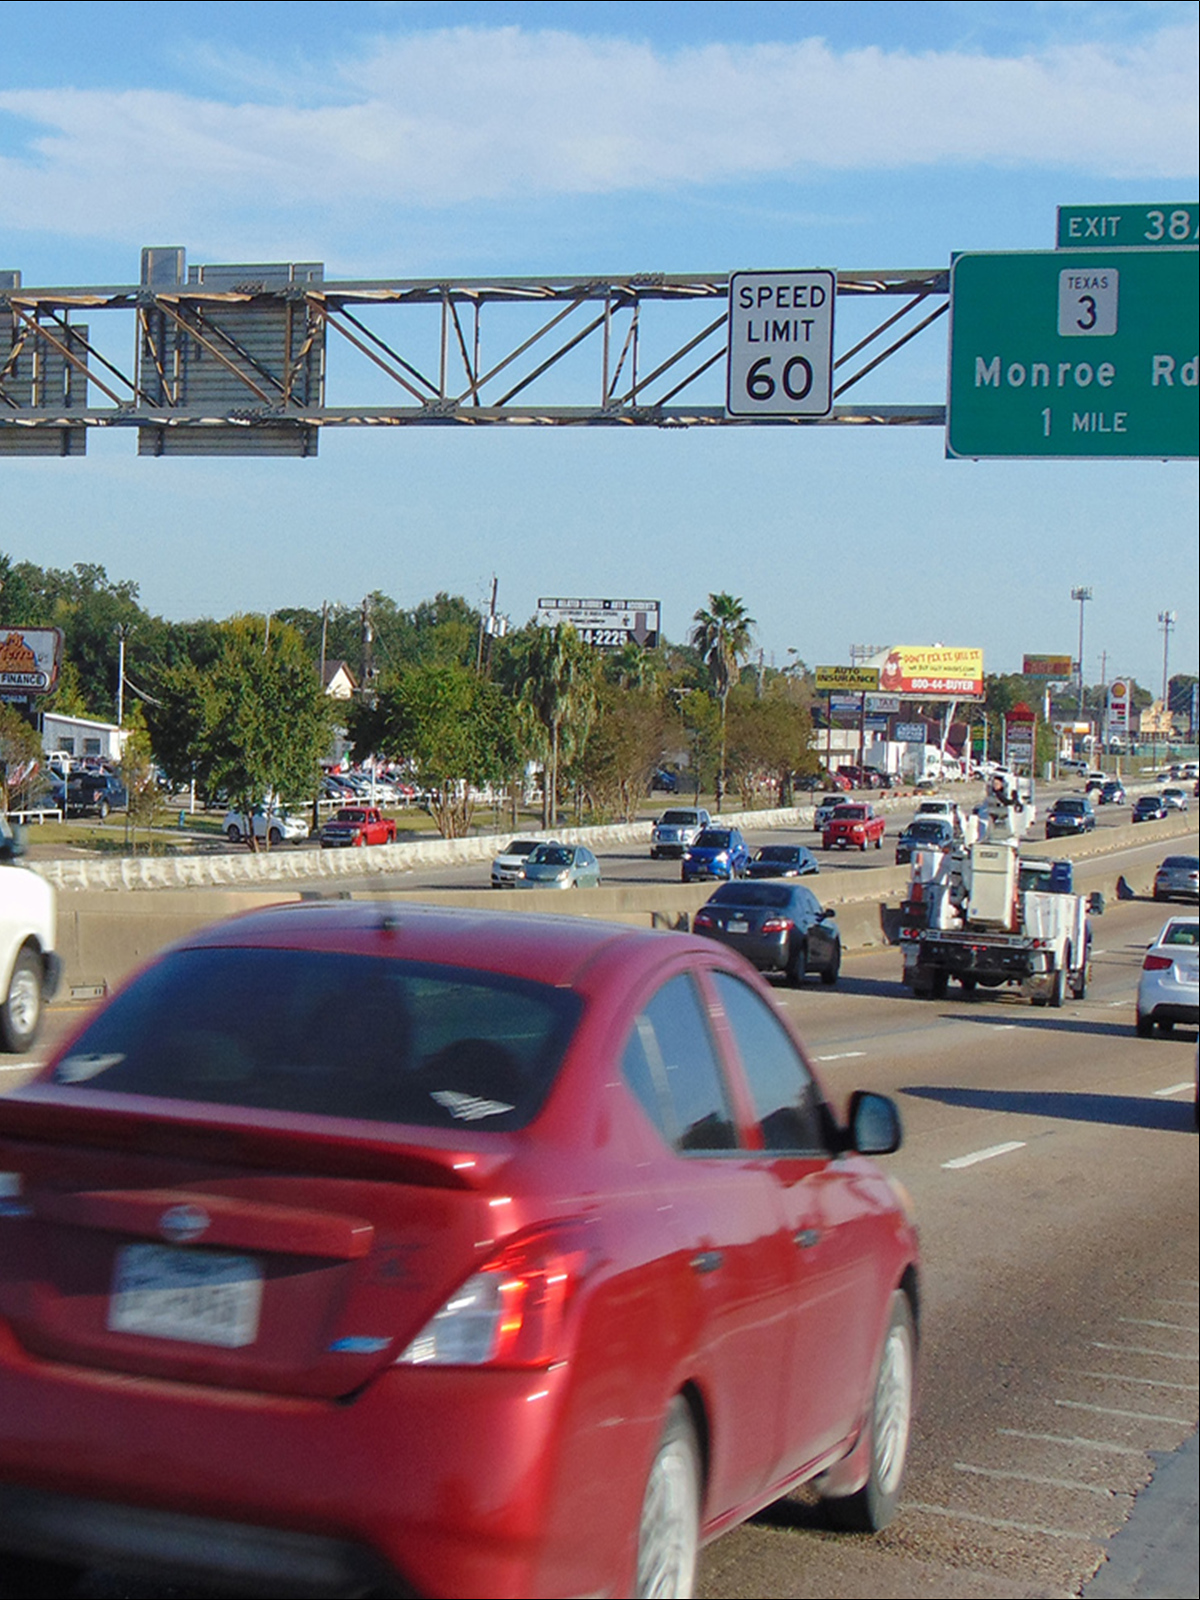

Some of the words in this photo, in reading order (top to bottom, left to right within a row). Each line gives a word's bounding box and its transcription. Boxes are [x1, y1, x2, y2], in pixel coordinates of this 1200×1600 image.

[1068, 216, 1121, 238] EXIT
[1144, 210, 1199, 241] 38
[1068, 275, 1108, 289] TEXAS
[739, 285, 826, 309] SPEED
[1077, 295, 1097, 330] 3
[747, 319, 815, 342] LIMIT
[746, 355, 813, 401] 60
[974, 356, 1116, 388] Monroe
[1152, 354, 1199, 387] Rd
[1041, 407, 1051, 437] 1
[1071, 412, 1128, 433] MILE
[1, 674, 42, 684] FINANCE
[817, 674, 876, 683] INSURANCE
[834, 667, 860, 675] AUTO
[910, 678, 974, 691] 800-44-BUYER
